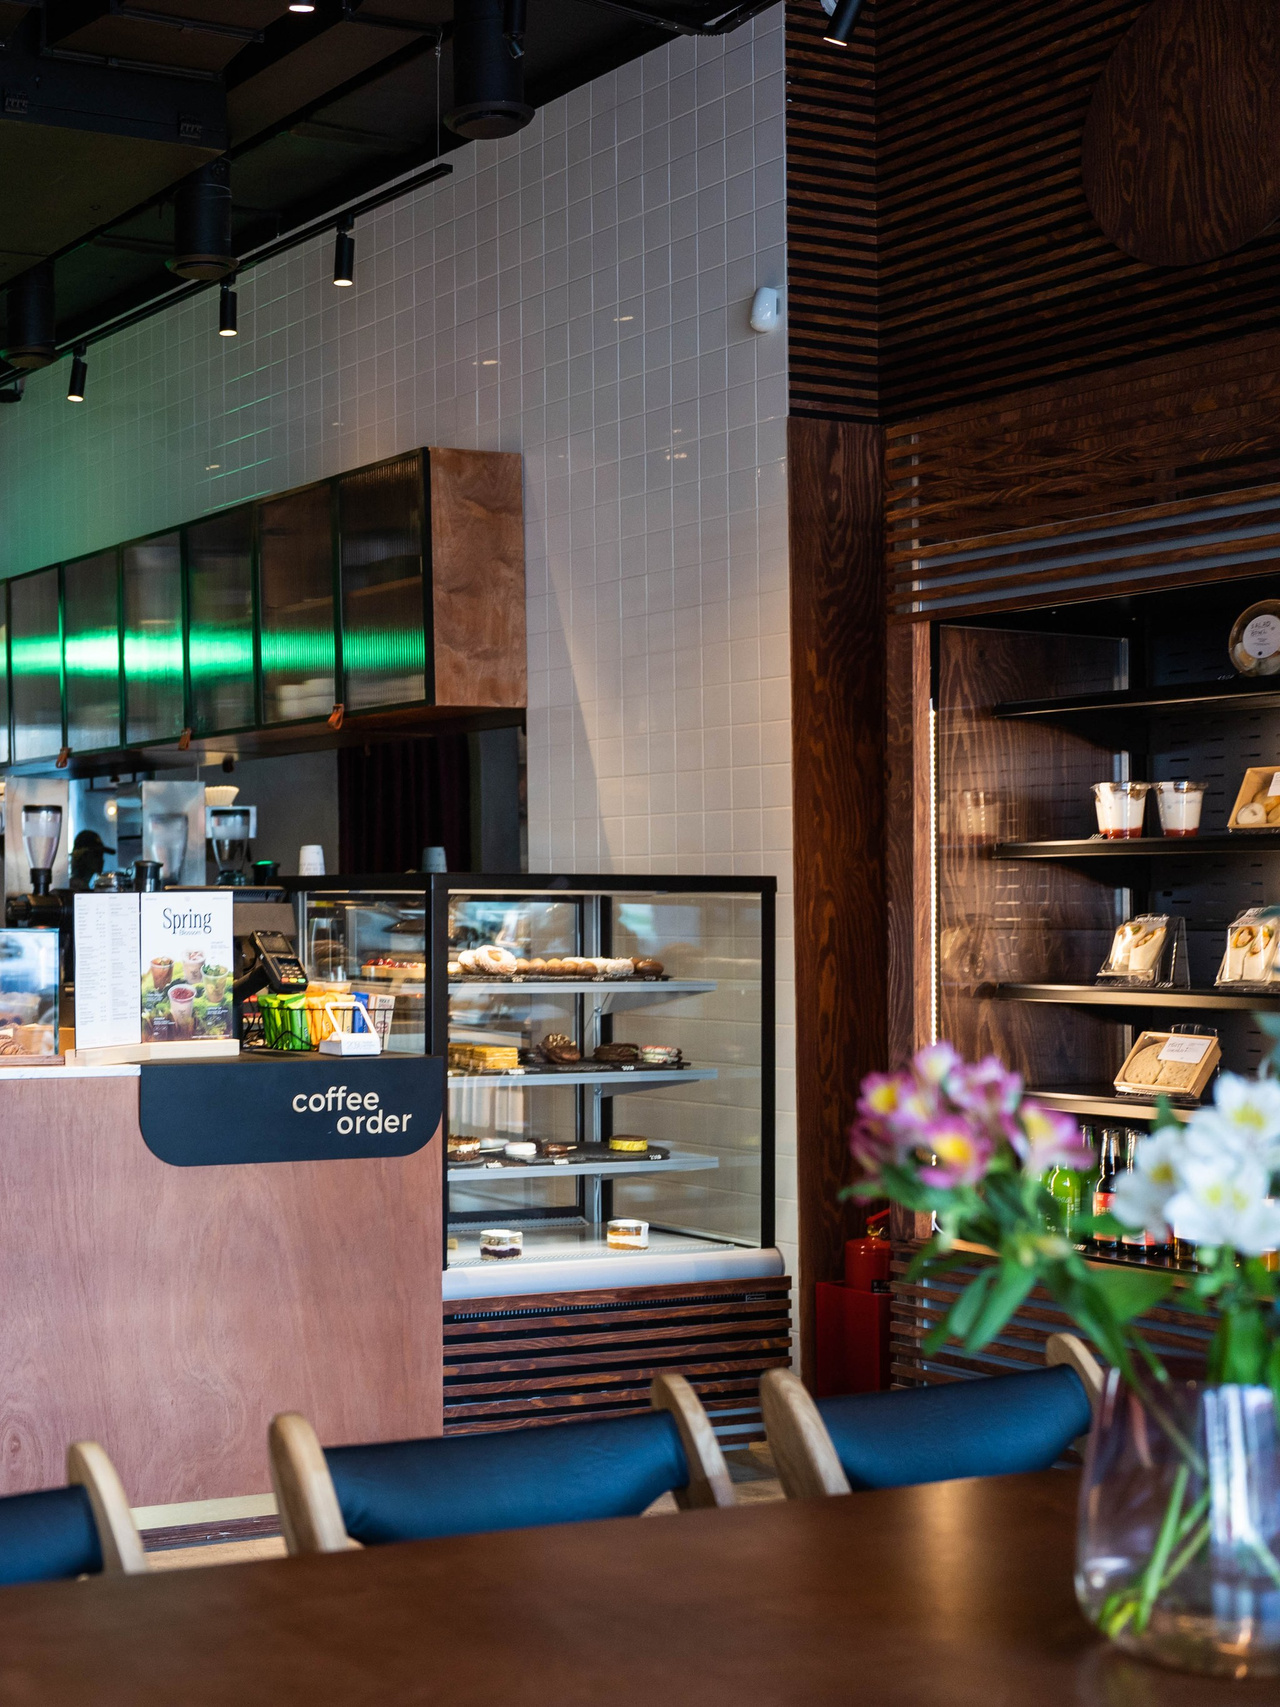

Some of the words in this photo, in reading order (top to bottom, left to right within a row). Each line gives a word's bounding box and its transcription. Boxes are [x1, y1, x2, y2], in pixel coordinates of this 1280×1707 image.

[162, 907, 212, 934] Spring
[292, 1085, 380, 1113] coffee
[336, 1109, 413, 1134] order
